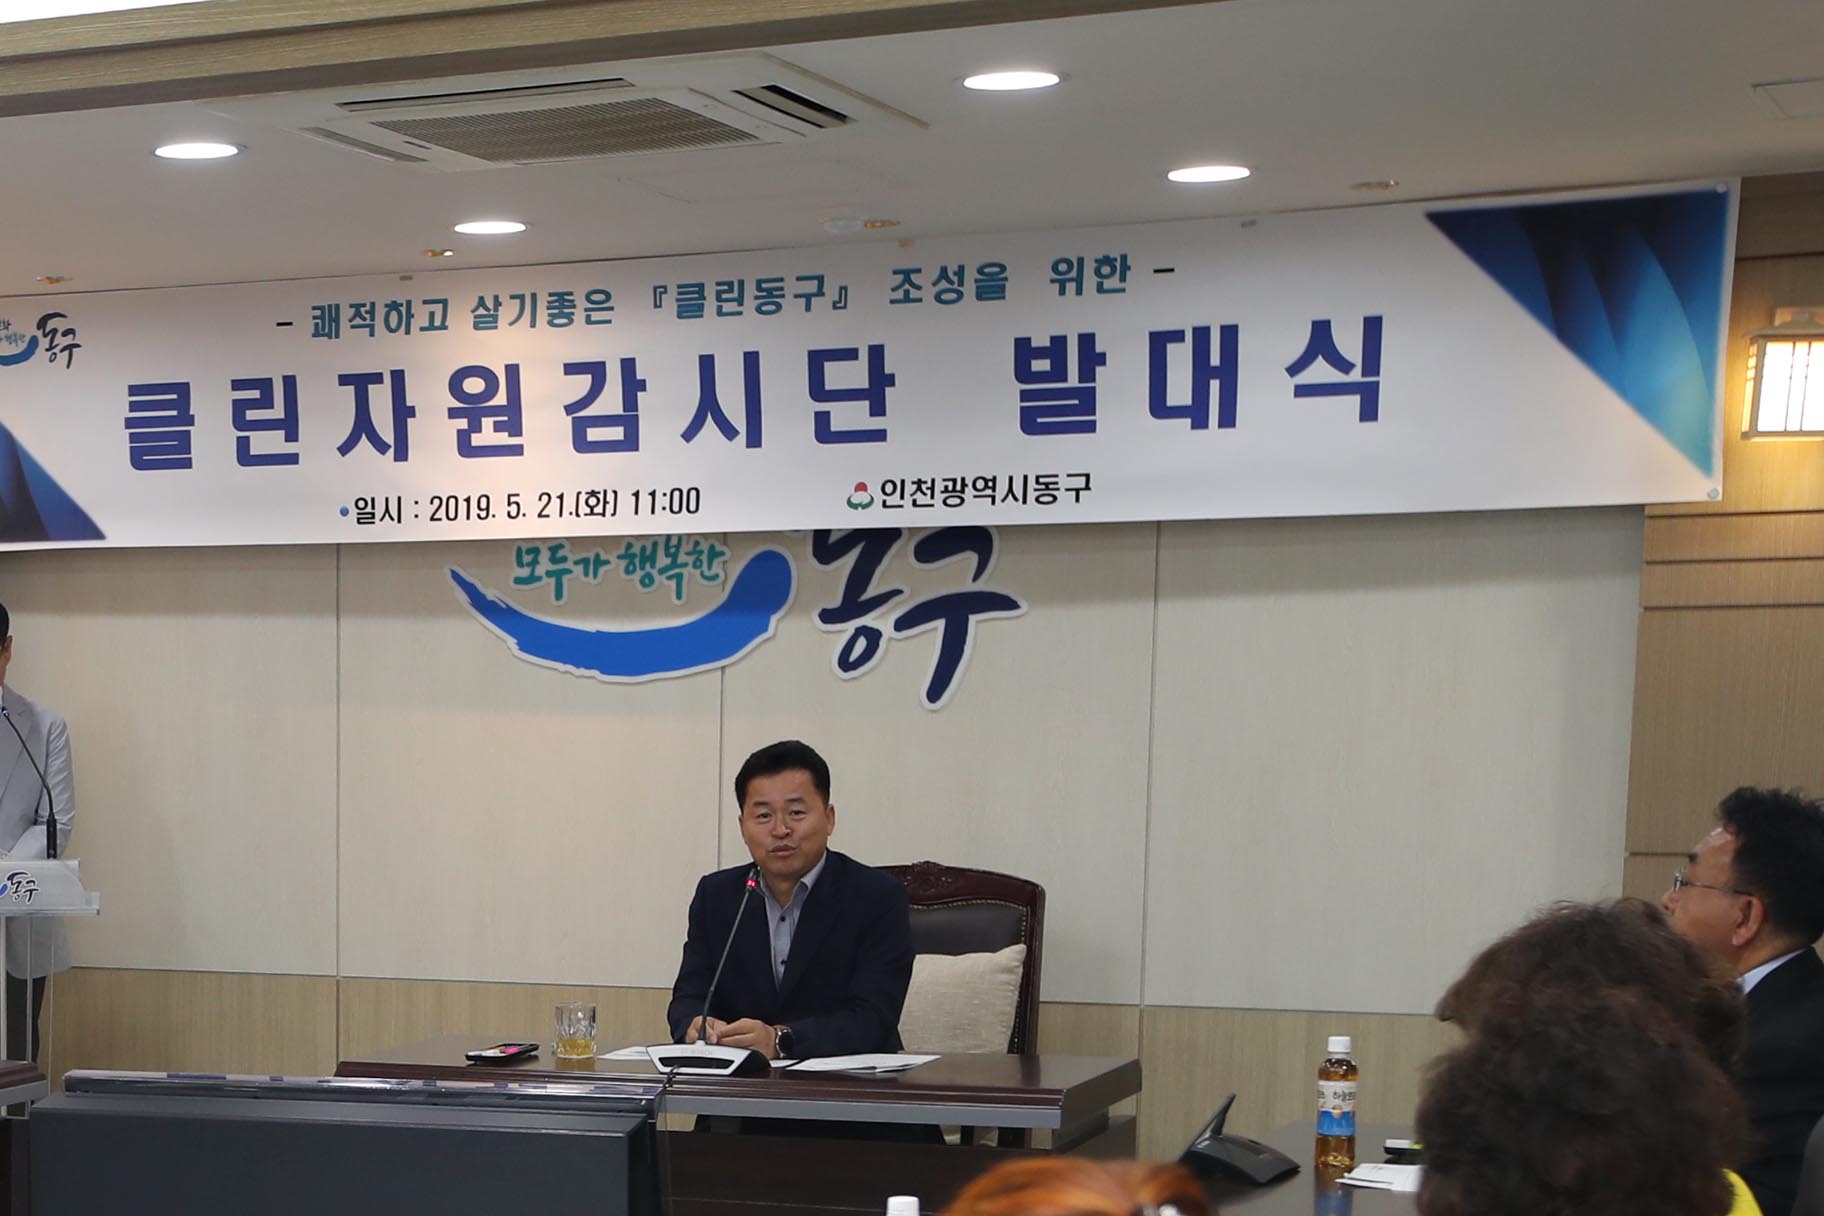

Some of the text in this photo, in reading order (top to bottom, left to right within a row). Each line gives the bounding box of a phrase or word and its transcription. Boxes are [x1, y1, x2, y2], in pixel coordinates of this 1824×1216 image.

[311, 298, 450, 340] 쾌적하고
[470, 287, 616, 331] 살기좋은
[889, 260, 1011, 306] 조성을
[1049, 253, 1133, 297] 위한
[36, 311, 82, 370] 동구
[1012, 314, 1384, 437] 발대식
[354, 496, 403, 526] 일시
[428, 494, 497, 523] 2019.
[505, 493, 527, 520] 5.
[631, 485, 701, 516] 11:00
[880, 472, 1093, 510] 인천광역시동구
[512, 536, 728, 603] 모두가 행복한
[6, 871, 40, 904] 동구
